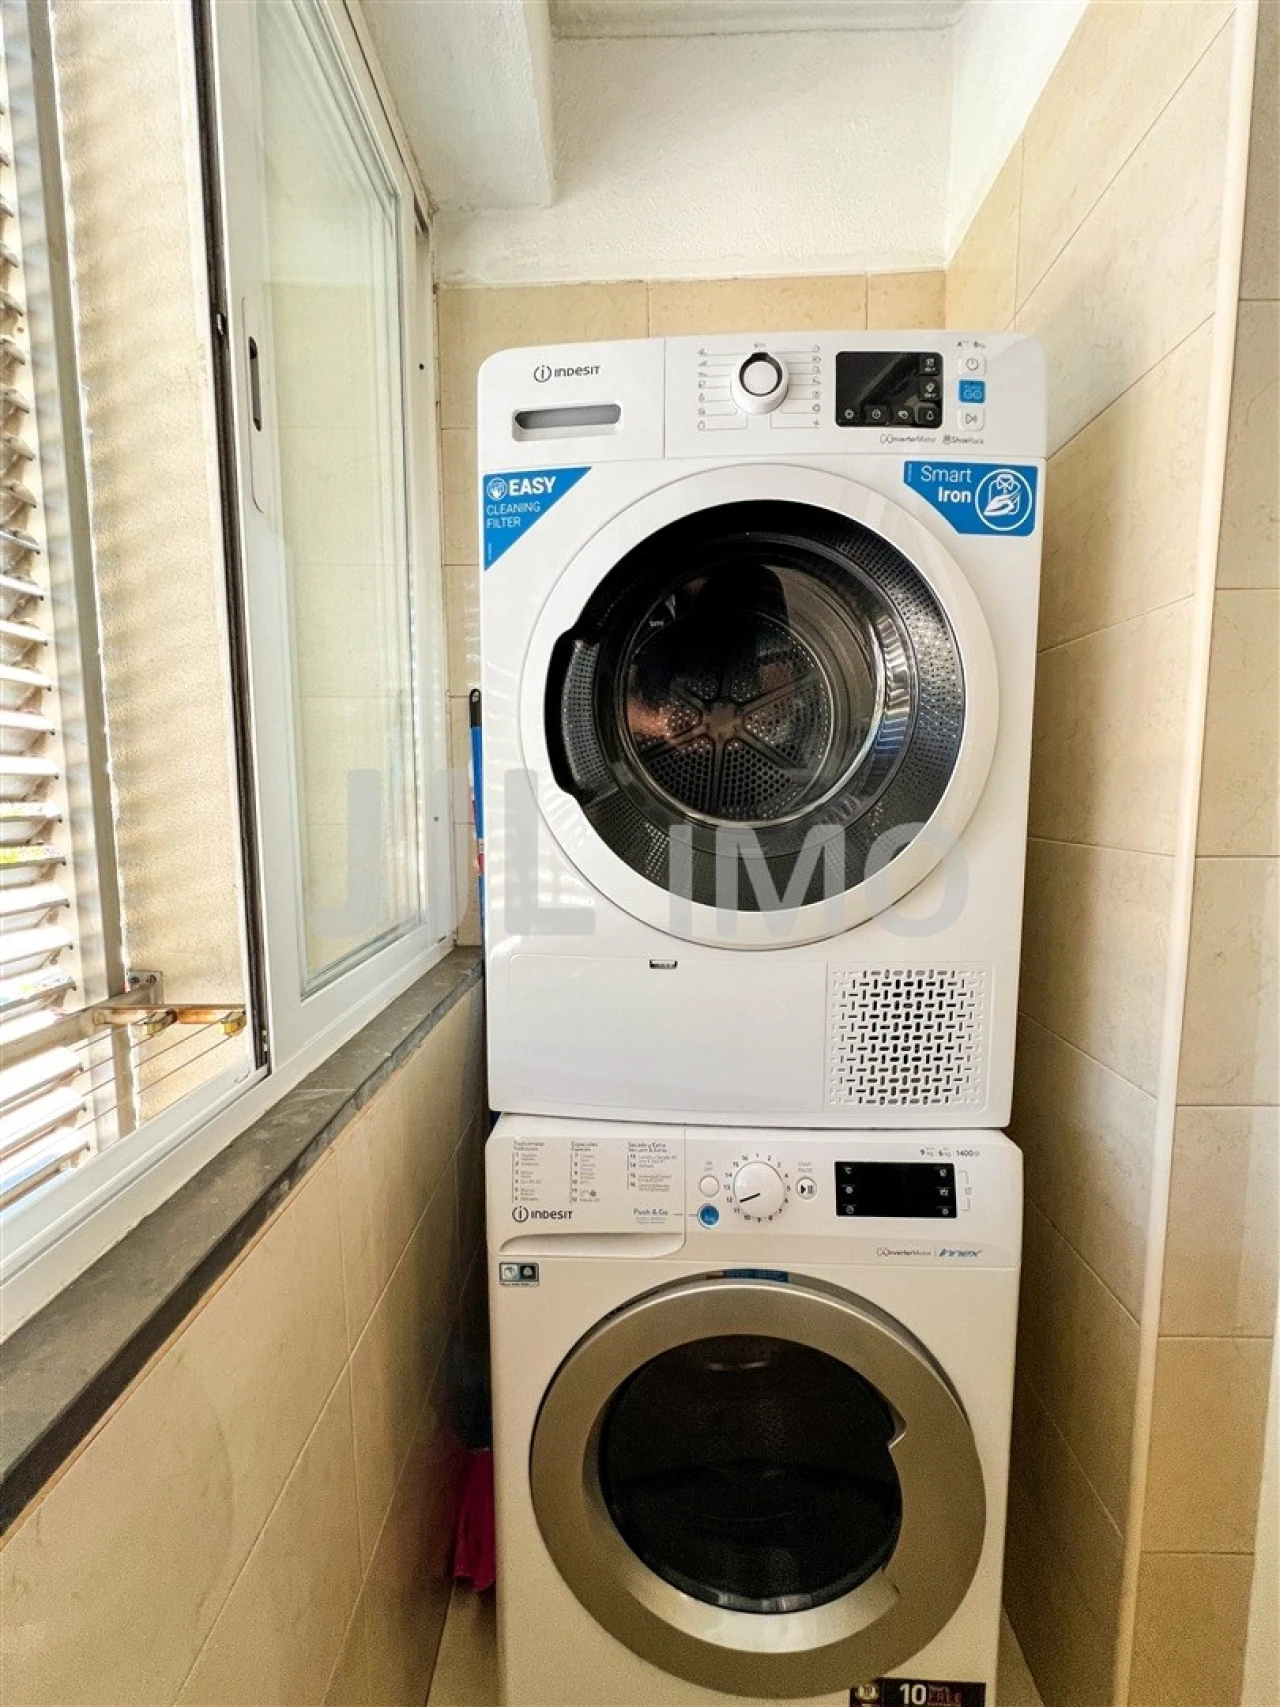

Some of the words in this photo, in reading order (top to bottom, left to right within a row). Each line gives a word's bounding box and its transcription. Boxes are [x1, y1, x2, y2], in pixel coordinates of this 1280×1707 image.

[554, 365, 600, 378] INDESIT
[920, 465, 972, 483] Smart
[509, 476, 556, 496] EASY
[938, 486, 971, 503] Iron
[486, 501, 541, 515] CLEANING
[486, 516, 521, 529] FILTER
[530, 1209, 574, 1220] INDESIT
[900, 1683, 927, 1705] 10
